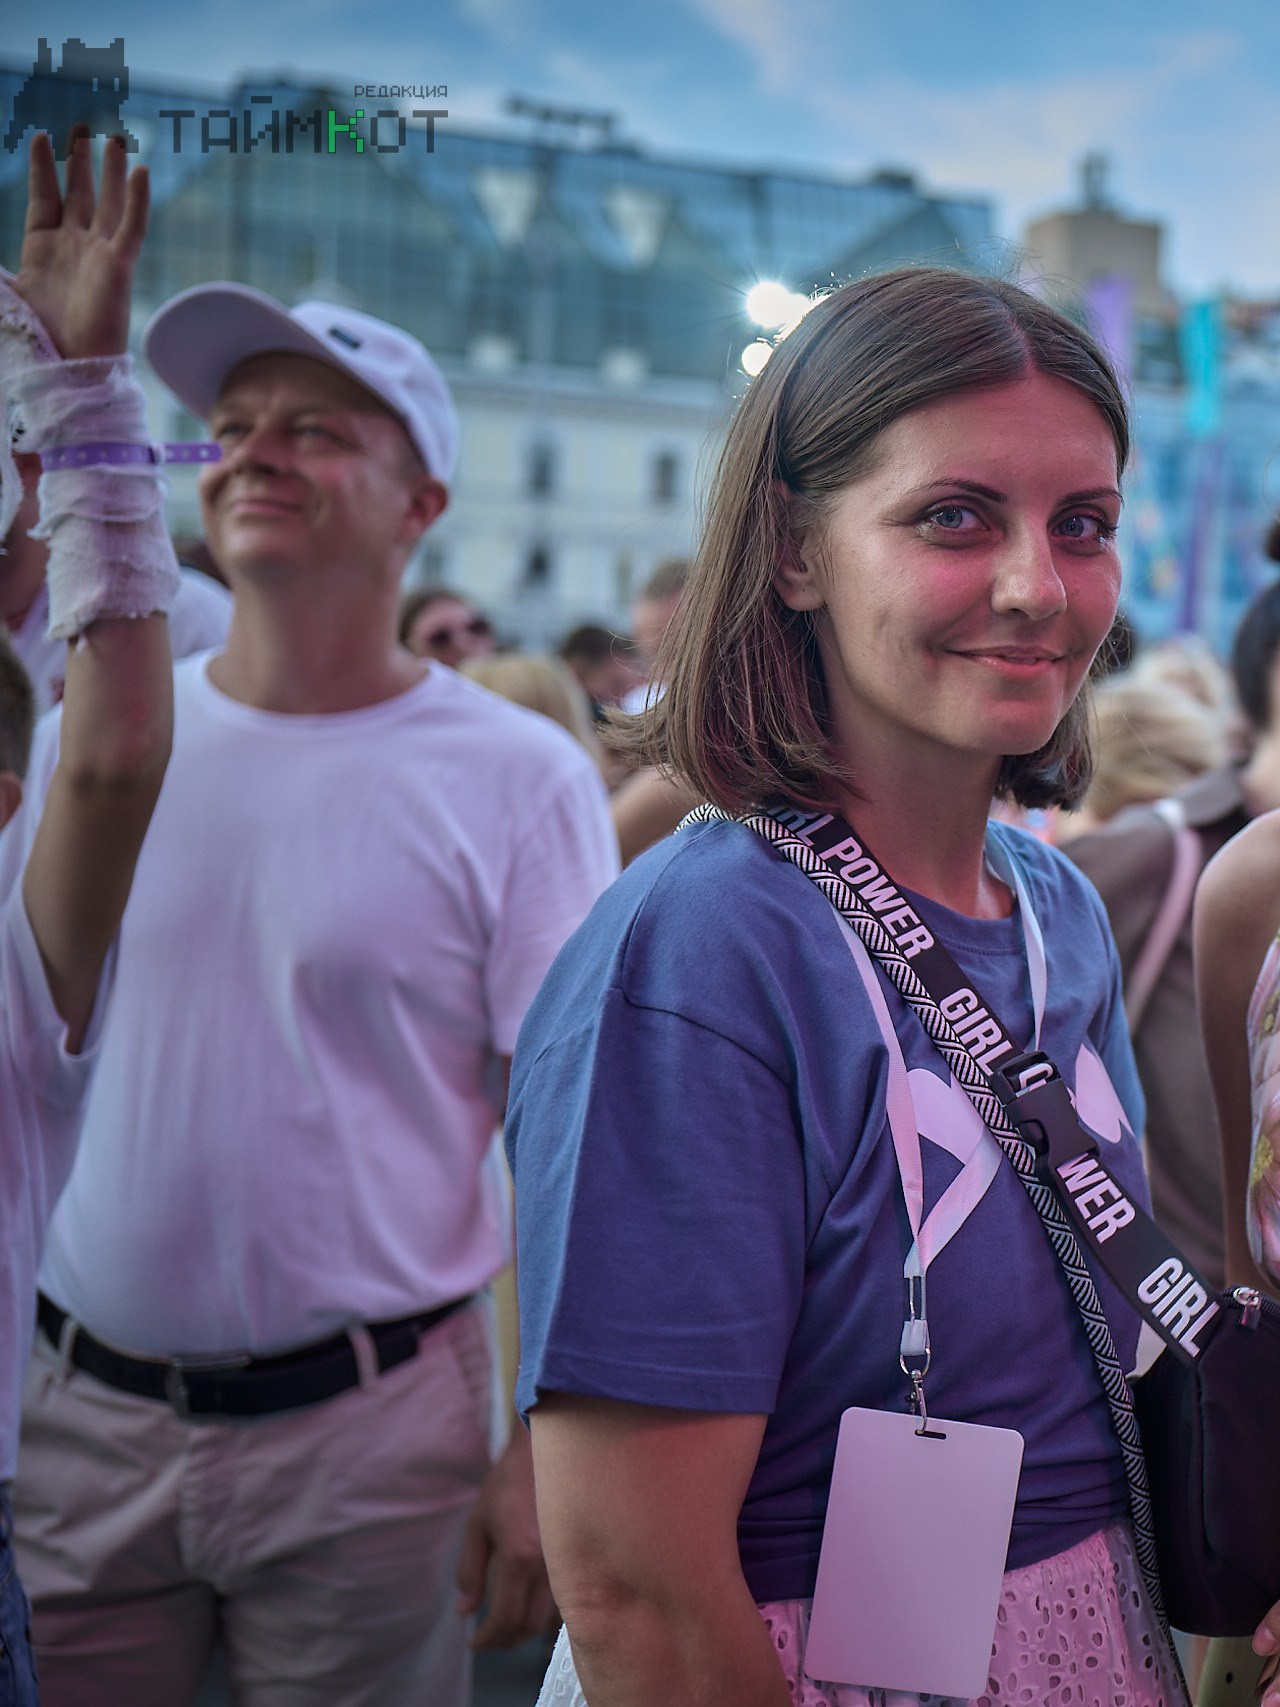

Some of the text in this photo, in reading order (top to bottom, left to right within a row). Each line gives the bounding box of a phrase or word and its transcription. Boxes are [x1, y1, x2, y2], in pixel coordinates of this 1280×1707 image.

[819, 836, 935, 960] POWER
[939, 988, 1014, 1077] GIRL
[1137, 1256, 1220, 1357] GIRL
